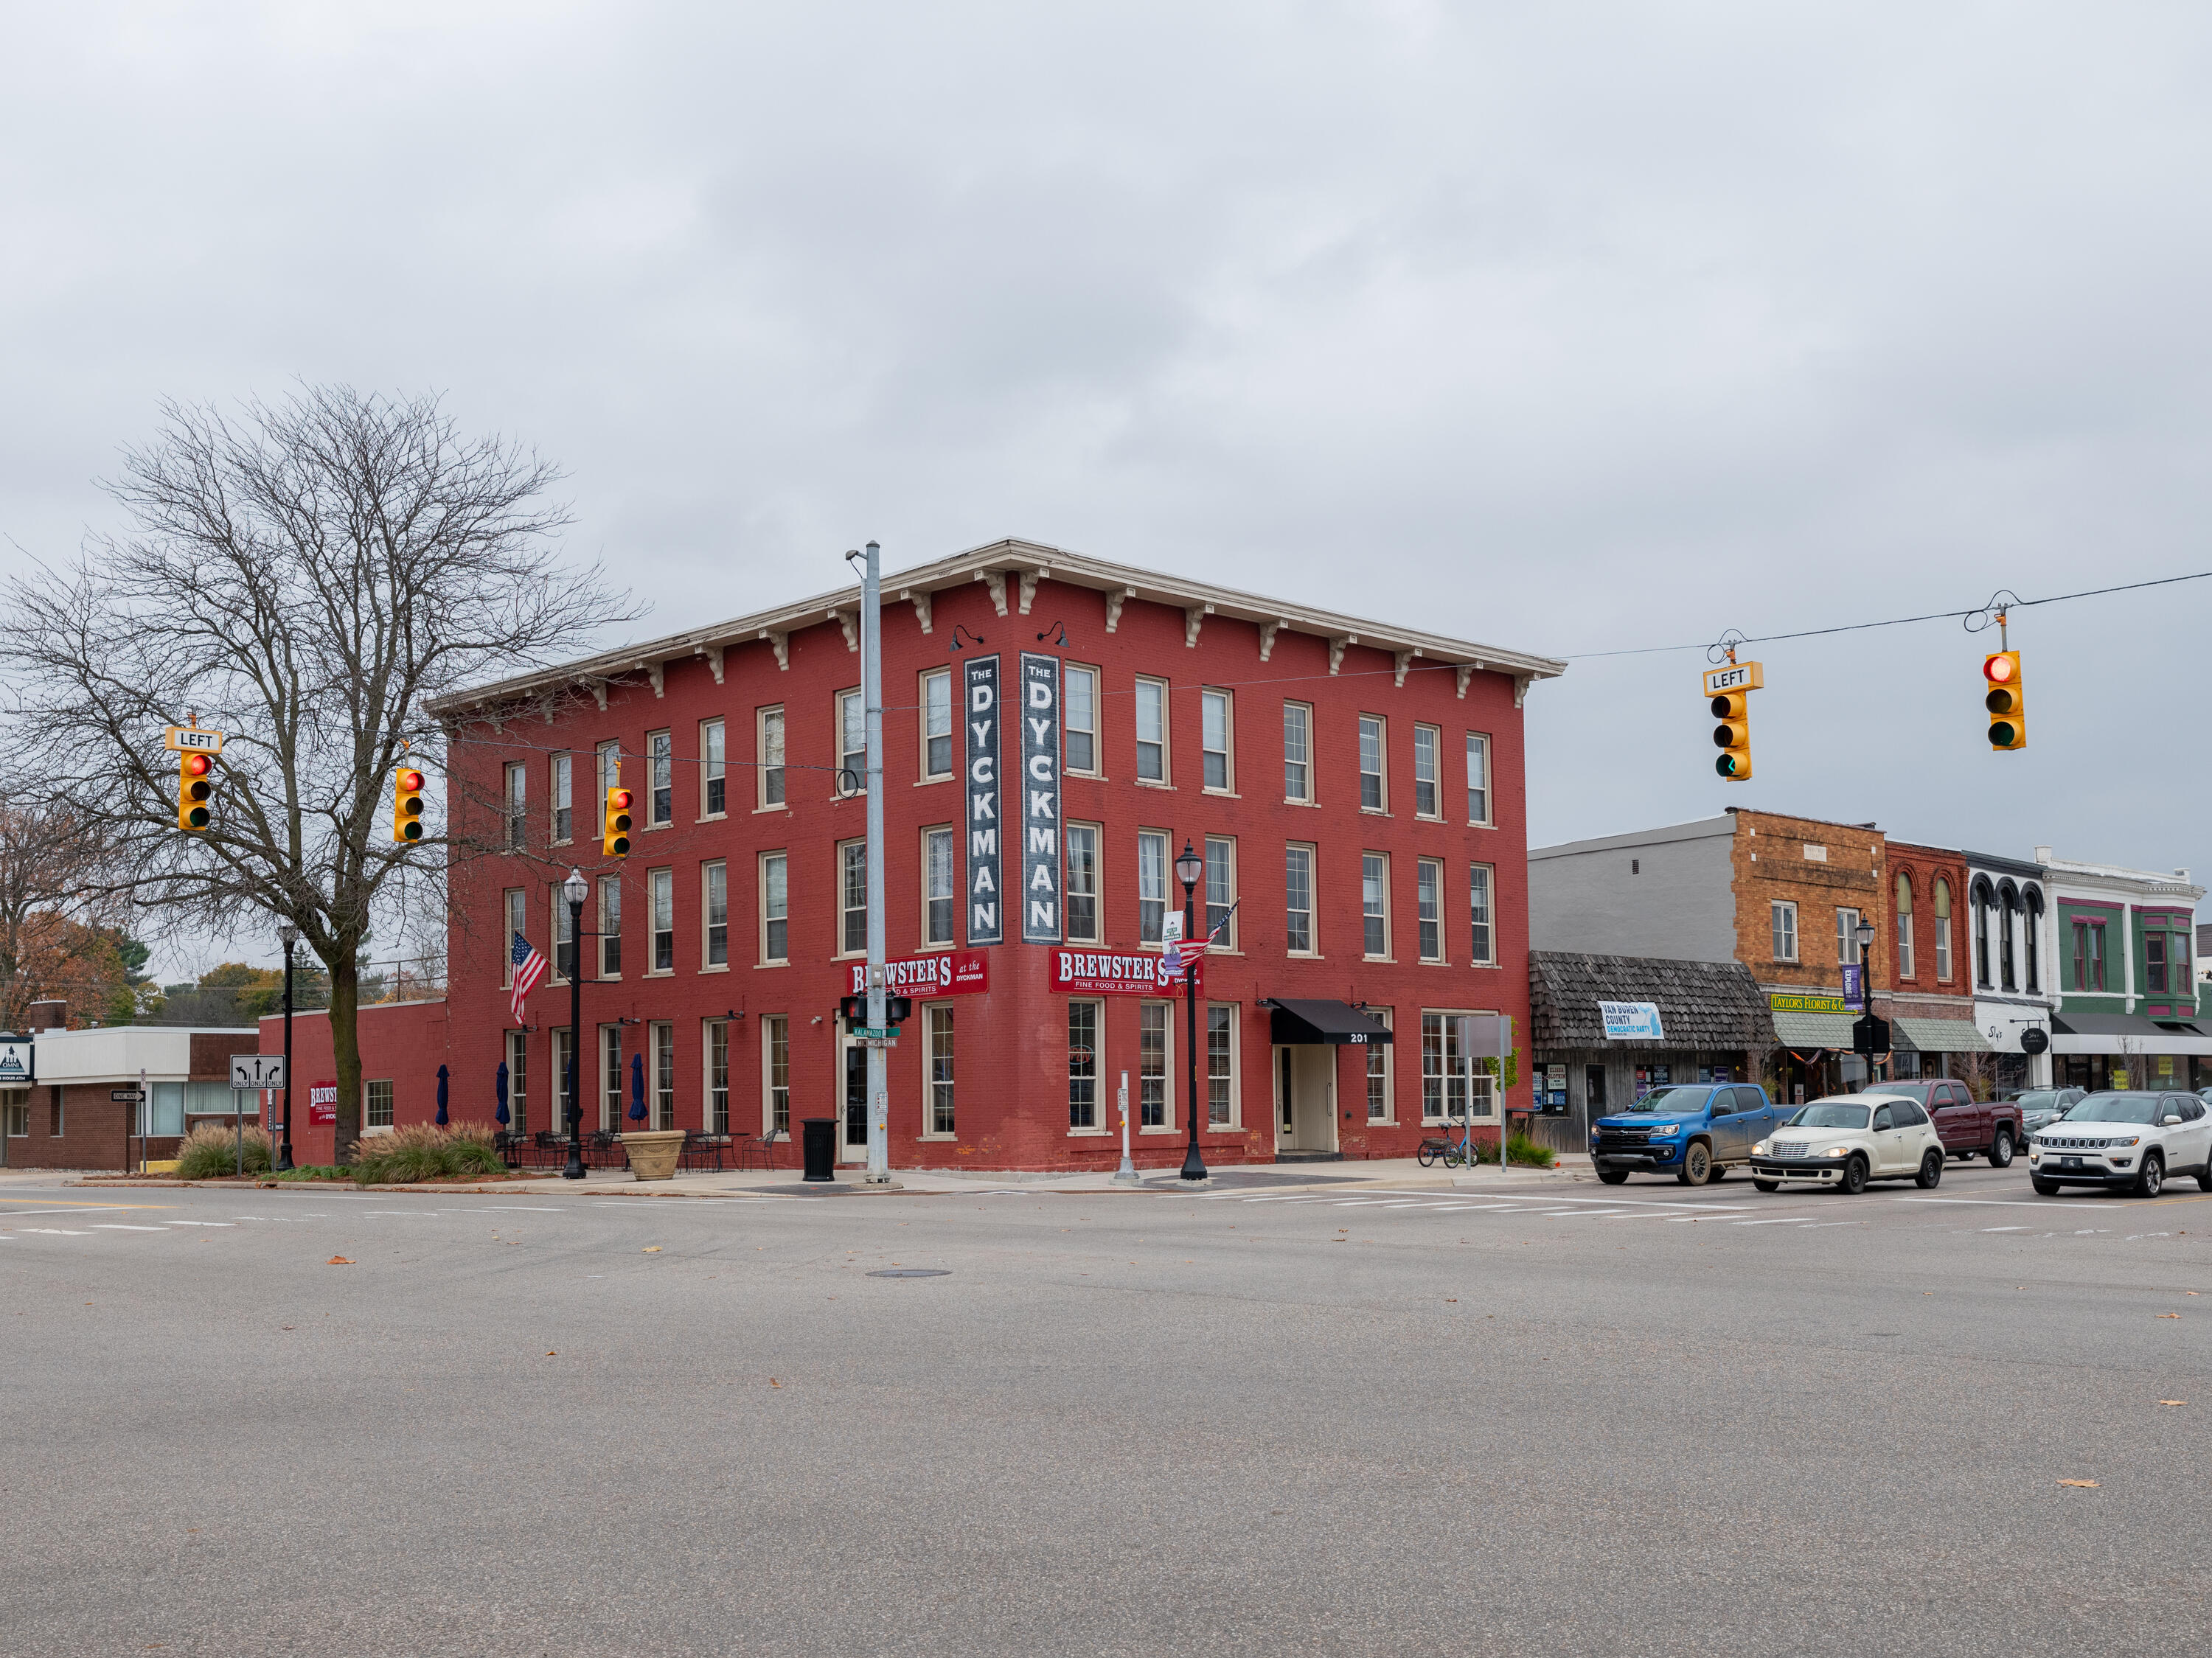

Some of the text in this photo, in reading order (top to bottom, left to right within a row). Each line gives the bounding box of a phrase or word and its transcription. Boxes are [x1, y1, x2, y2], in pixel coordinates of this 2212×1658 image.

[971, 669, 992, 680] THE
[1028, 665, 1051, 678] THE
[1713, 669, 1744, 689] LEFT
[181, 733, 212, 748] LEFT
[971, 684, 996, 930] DYCKMAN
[1029, 681, 1055, 928] DYCKMAN
[959, 960, 980, 973] at the
[1059, 952, 1169, 986] BREWSTER'S
[852, 956, 952, 994] BWSTER'S
[956, 973, 983, 982] DYCKMAN
[910, 986, 936, 994] SPIRITS
[1602, 1005, 1638, 1014] VAN BUREN
[1773, 996, 1803, 1009] TAYLOR'S
[1804, 998, 1831, 1010] FLORIST
[1832, 999, 1837, 1010] &
[1605, 1014, 1630, 1025] COUNTY
[1350, 1034, 1368, 1042] 201
[1988, 1025, 2003, 1042] Sly's
